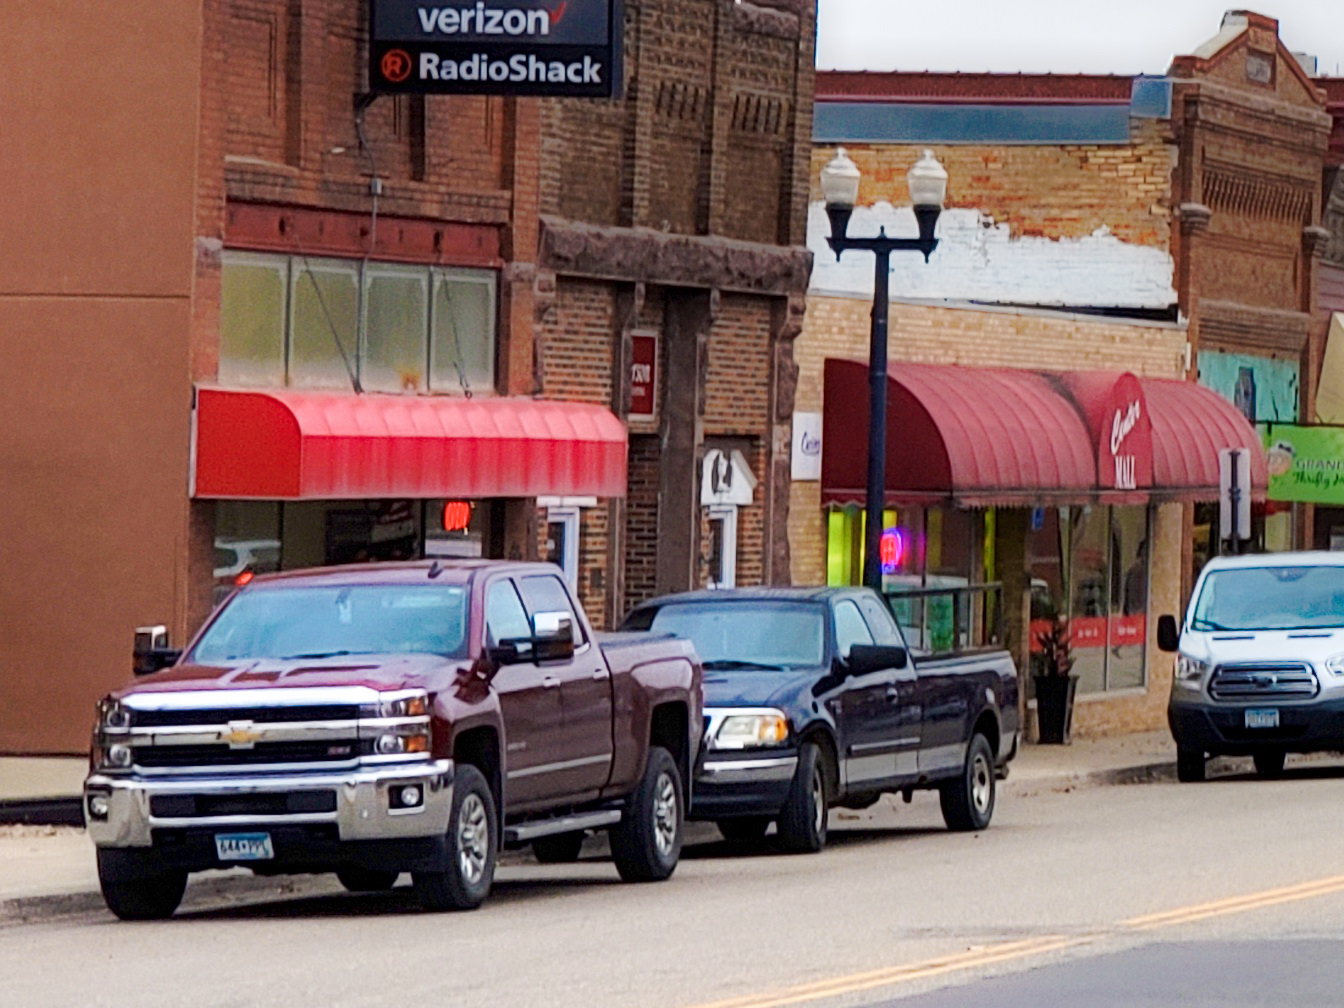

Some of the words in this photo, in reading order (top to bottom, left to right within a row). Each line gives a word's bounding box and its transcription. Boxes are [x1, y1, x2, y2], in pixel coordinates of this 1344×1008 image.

[418, 1, 549, 36] verizon
[419, 52, 602, 84] RadioShack
[1115, 455, 1136, 490] MALL
